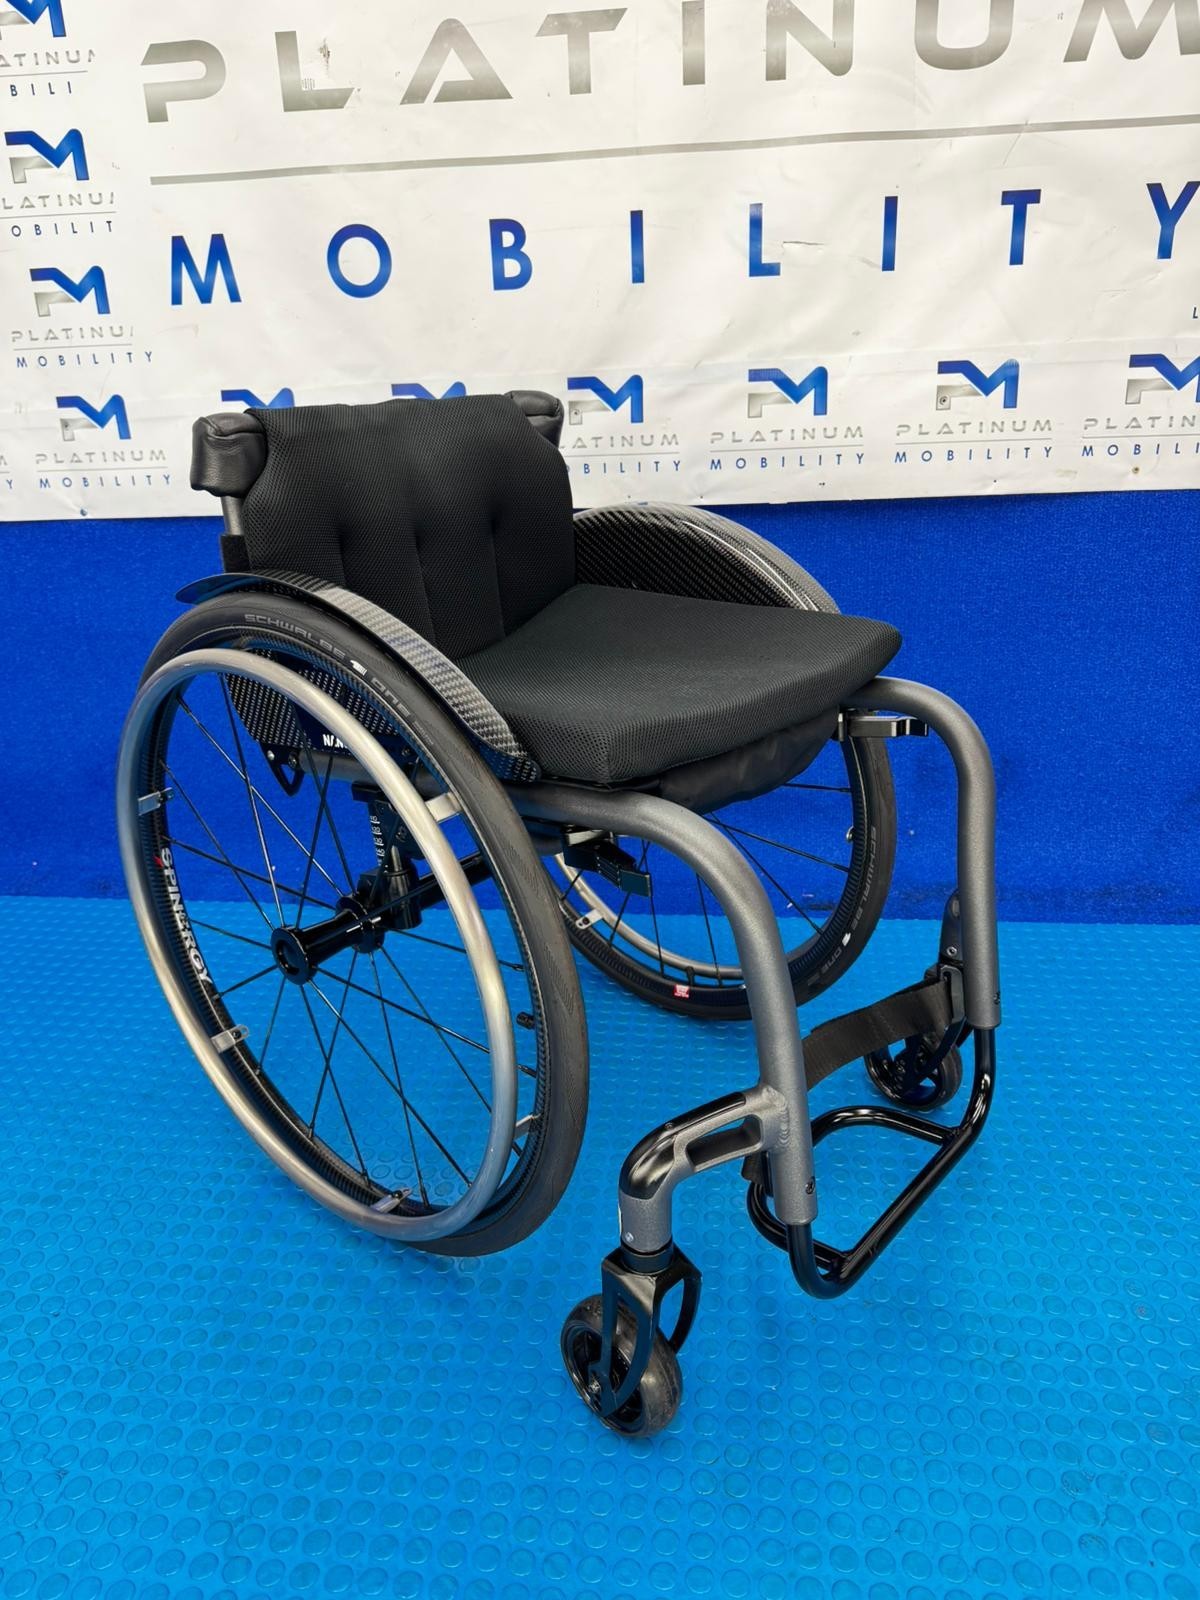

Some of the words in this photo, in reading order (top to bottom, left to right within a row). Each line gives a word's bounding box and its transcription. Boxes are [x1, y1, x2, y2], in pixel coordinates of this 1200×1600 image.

[11, 220, 112, 237] OBILIT
[171, 181, 1200, 305] MOBILITY
[16, 352, 152, 368] MOBILITY
[896, 418, 1053, 437] PLATINUM
[1083, 415, 1197, 431] PLATIN
[560, 433, 679, 449] ATINUM
[709, 425, 864, 444] PLATINUM
[35, 449, 168, 464] PLATINUM
[895, 446, 1053, 464] MOBILITY
[1081, 442, 1200, 458] MOBILI
[567, 460, 680, 474] BILITY
[709, 453, 864, 471] MOBILITY
[39, 474, 171, 489] MOBILITY
[244, 613, 346, 660] SCHWALBE
[160, 847, 214, 986] SPINERGY
